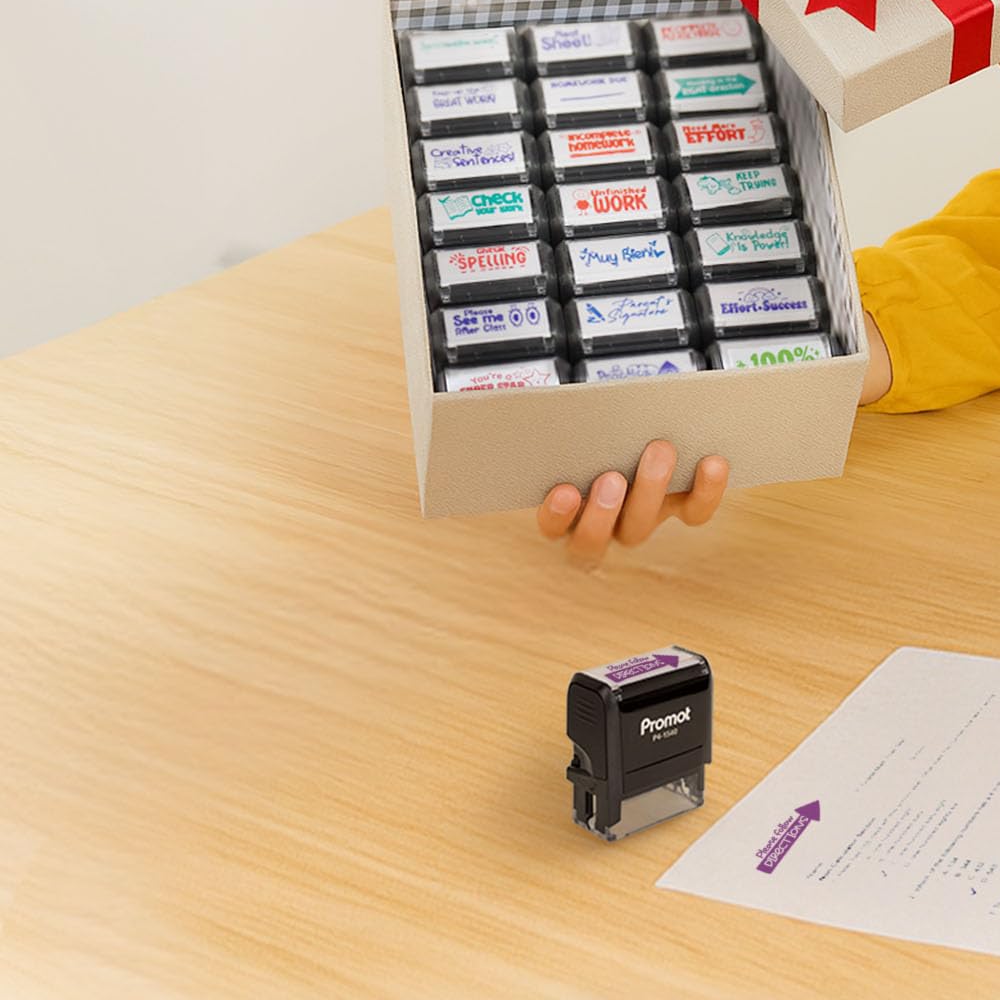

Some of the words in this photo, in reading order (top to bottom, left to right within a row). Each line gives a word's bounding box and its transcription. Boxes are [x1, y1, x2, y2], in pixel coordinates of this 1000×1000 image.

[684, 127, 746, 144] EFFORT
[592, 192, 648, 213] WORK
[453, 314, 479, 327] See
[482, 312, 504, 324] me
[640, 706, 691, 736] Promot
